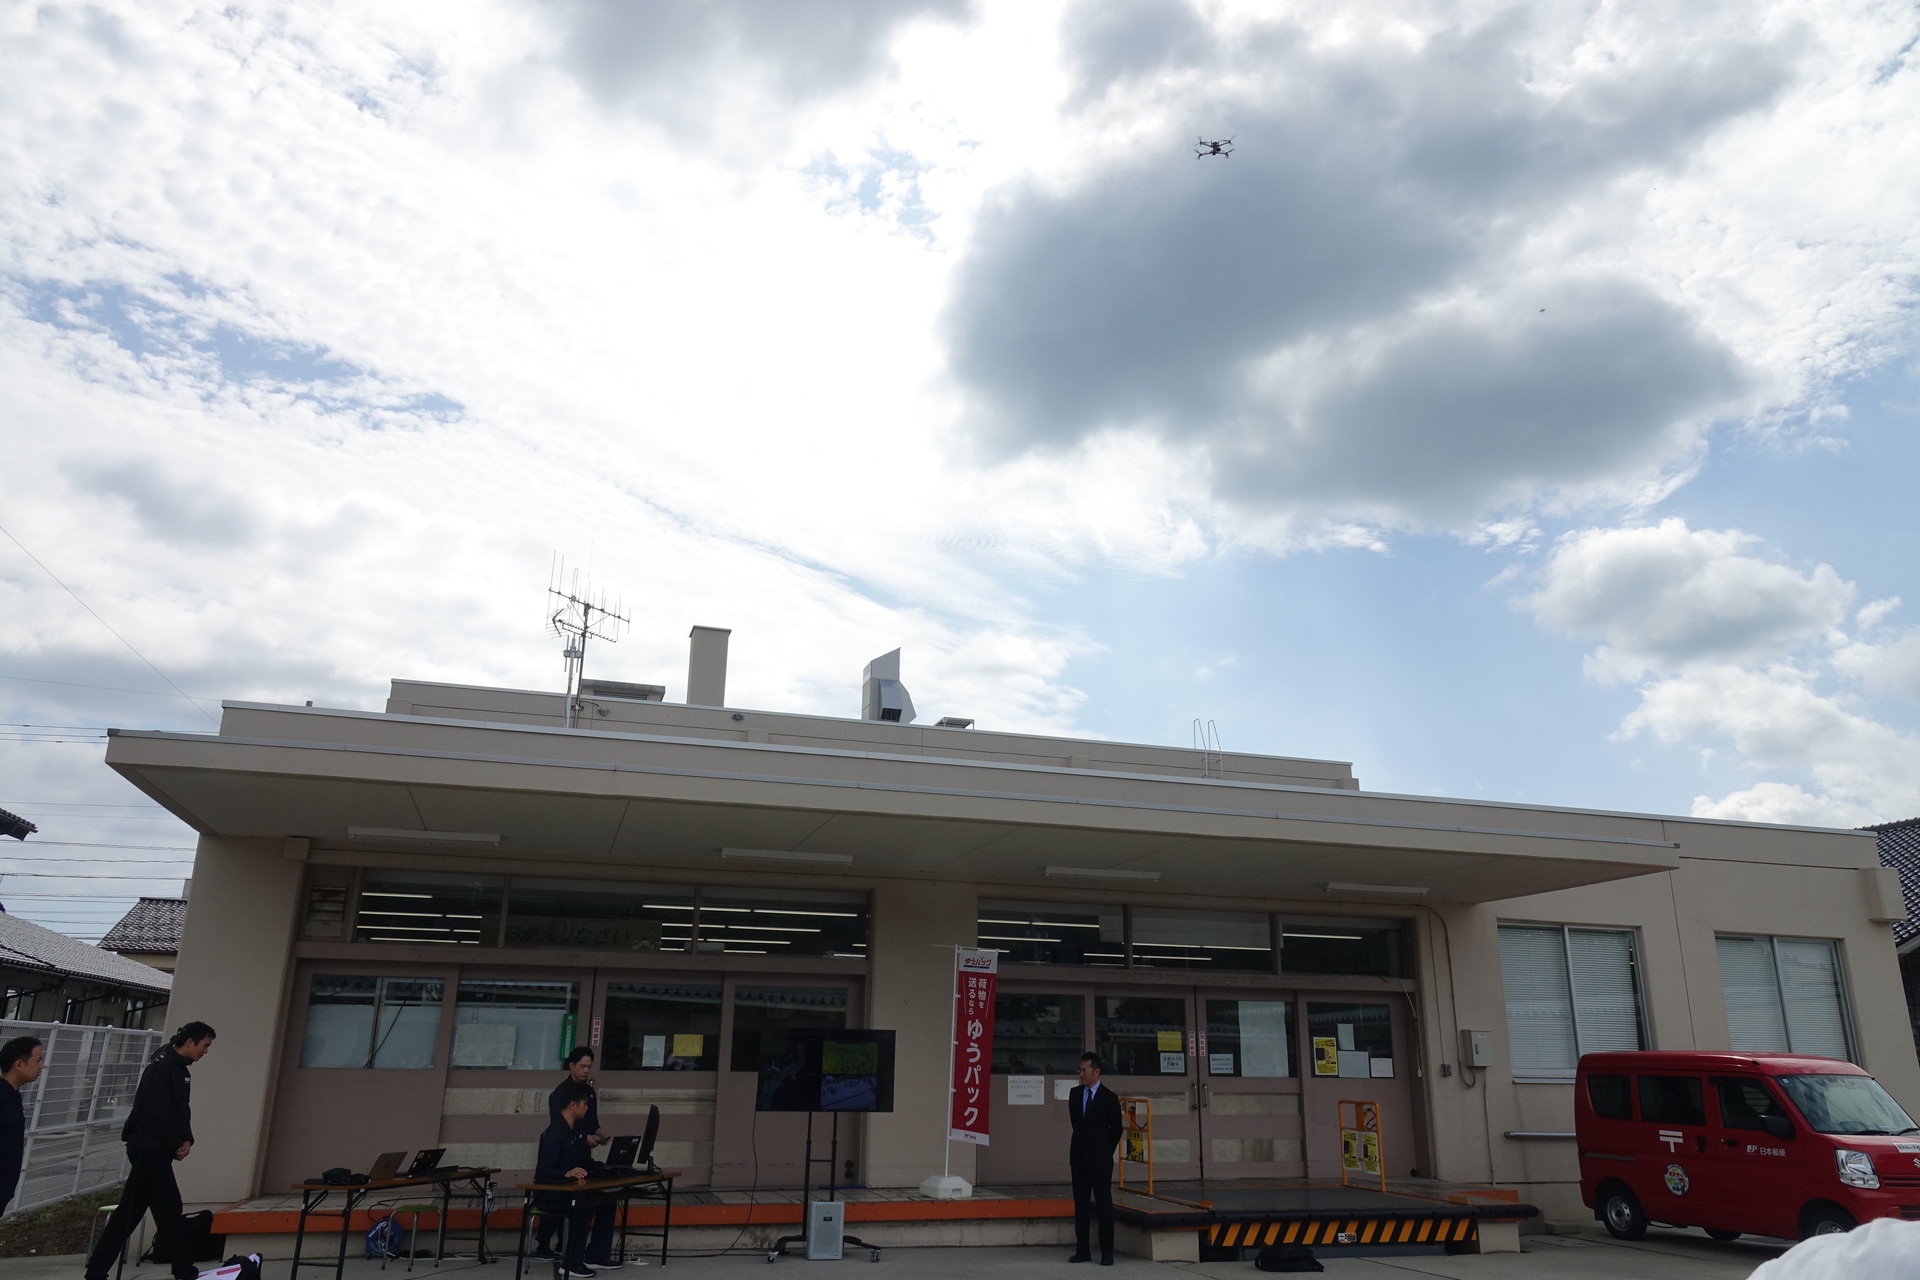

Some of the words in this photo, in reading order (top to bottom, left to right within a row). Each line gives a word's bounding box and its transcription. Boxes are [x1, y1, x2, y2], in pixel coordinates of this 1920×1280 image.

[964, 956, 992, 967] ゆうパック
[967, 977, 977, 1015] 送るなら
[978, 977, 988, 1009] 荷物を
[963, 1018, 984, 1128] ゆうパック
[1759, 1147, 1787, 1157] 日本郵便
